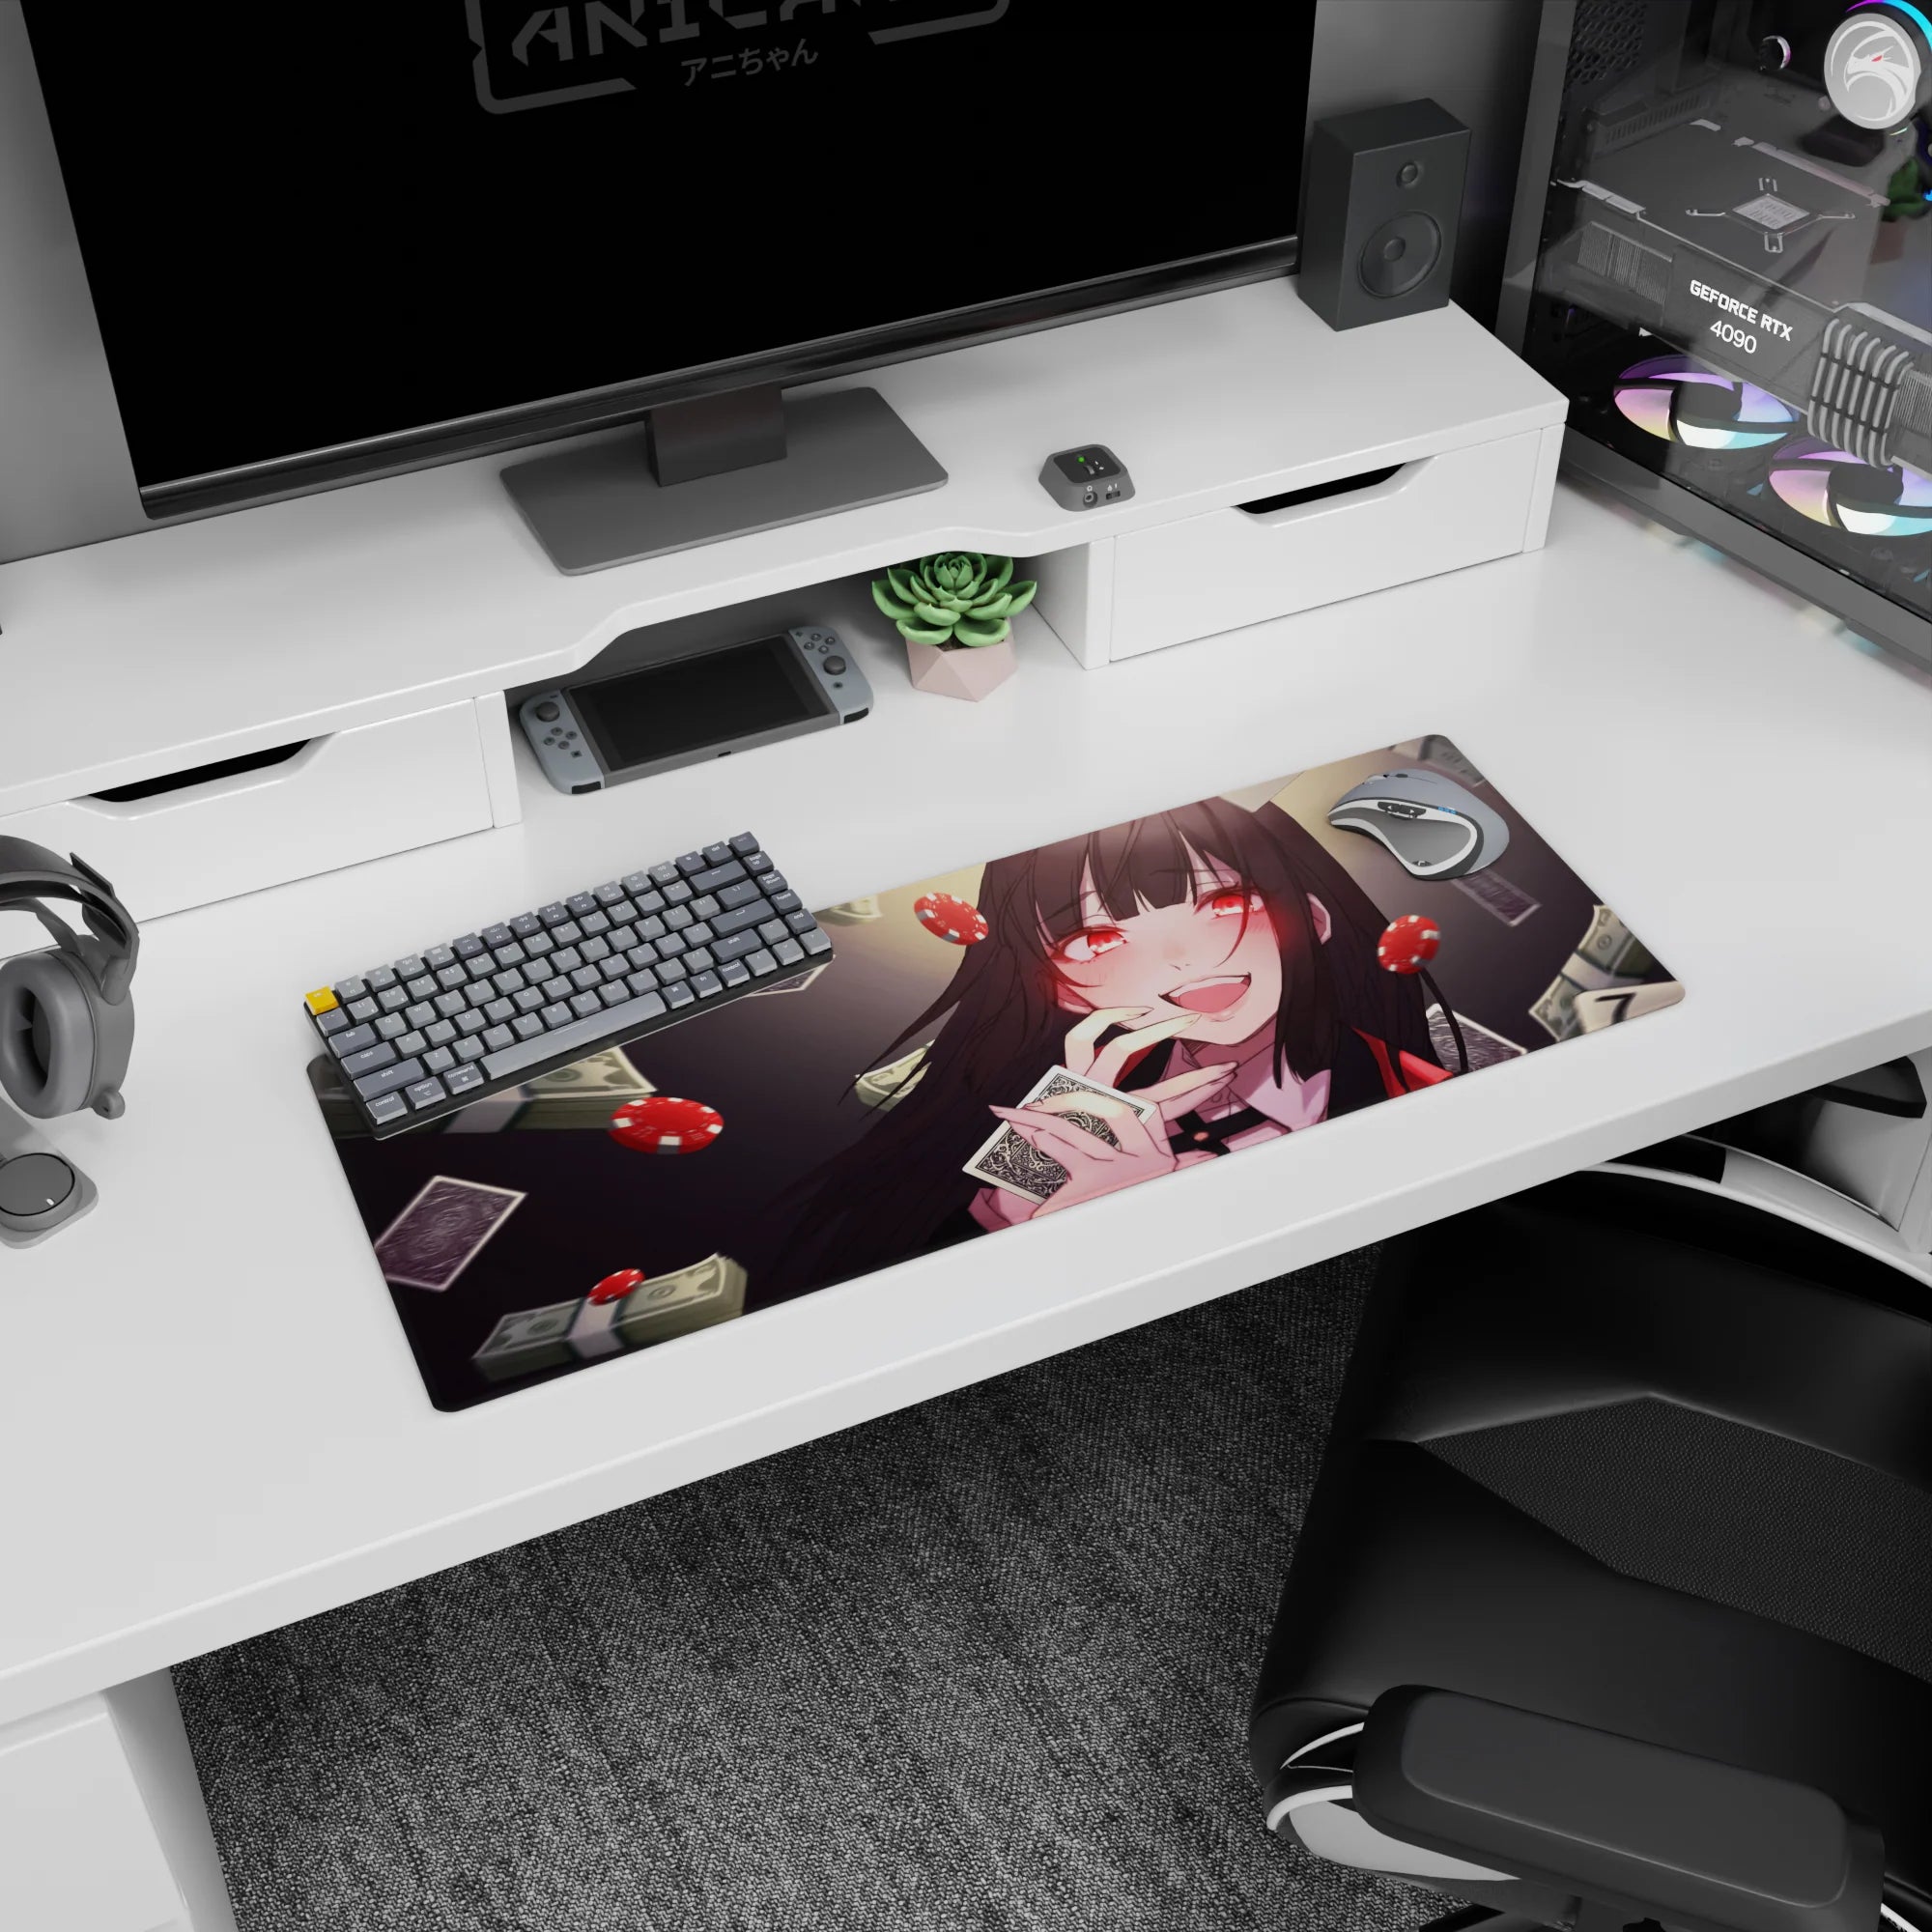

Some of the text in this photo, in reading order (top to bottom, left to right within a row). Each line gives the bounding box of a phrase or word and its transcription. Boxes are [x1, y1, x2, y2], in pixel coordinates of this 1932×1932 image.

[680, 38, 819, 87] アニちゃん
[1690, 279, 1794, 342] GEFORCE RTX
[1710, 320, 1757, 355] 4090
